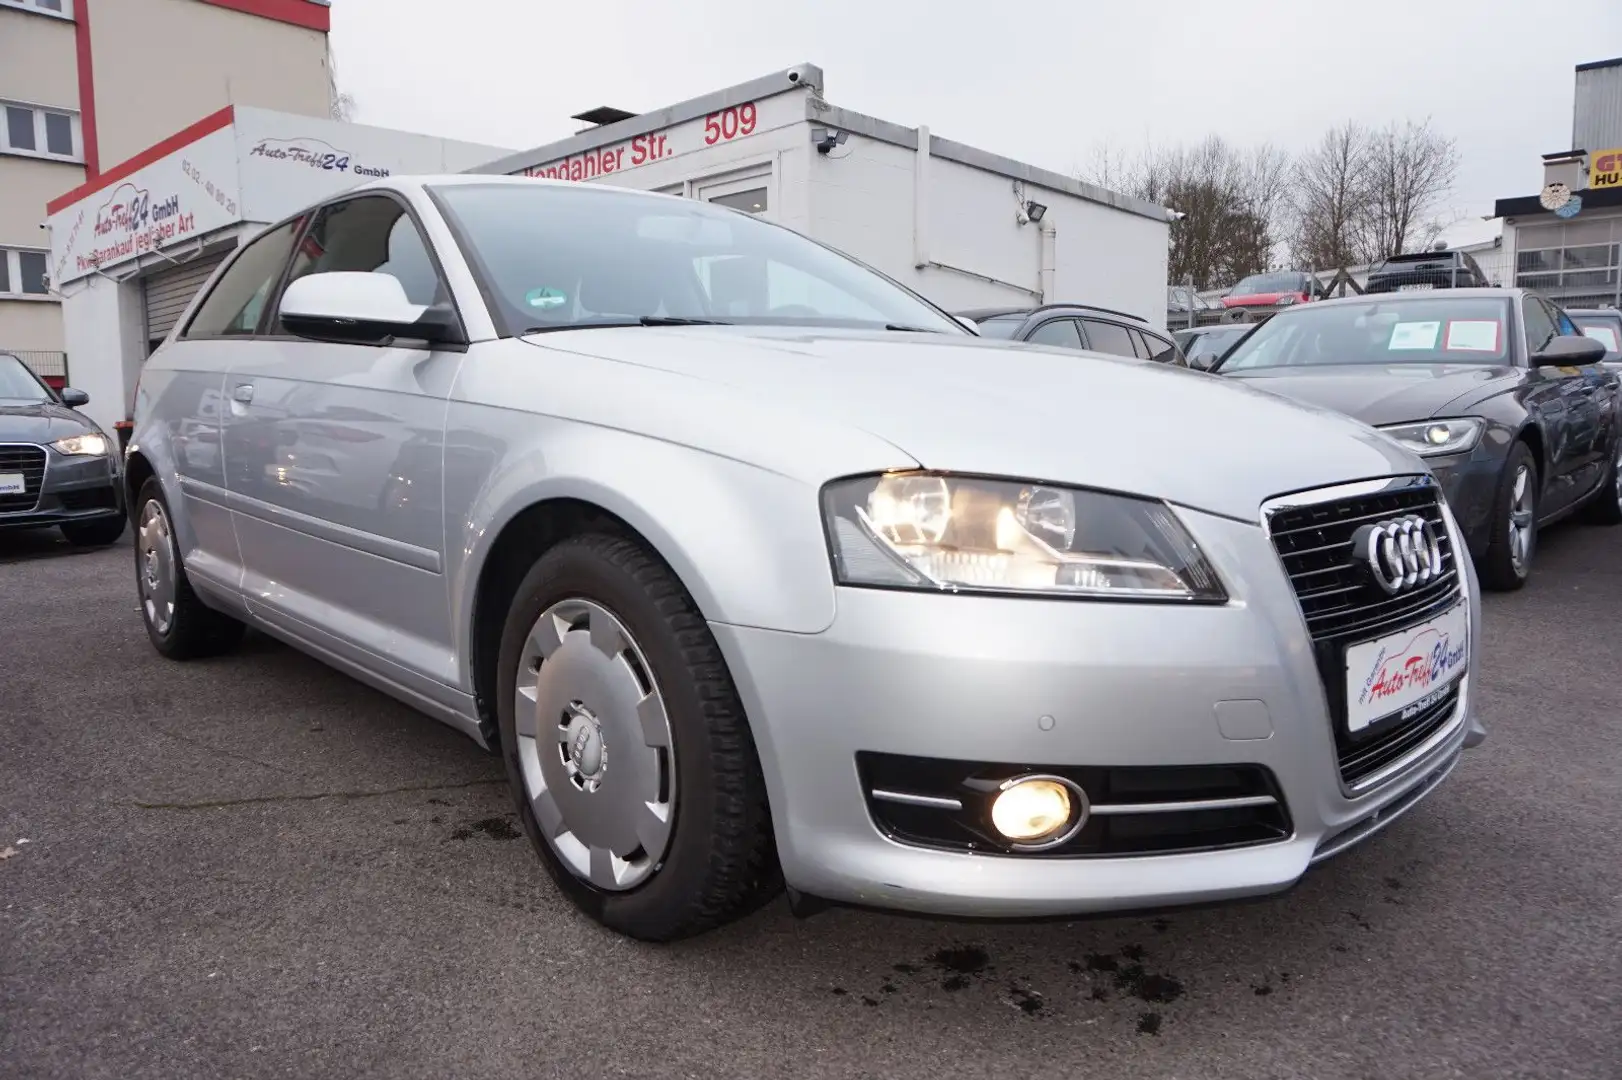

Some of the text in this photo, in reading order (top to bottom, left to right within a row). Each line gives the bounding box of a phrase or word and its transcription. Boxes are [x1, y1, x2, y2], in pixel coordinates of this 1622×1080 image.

[631, 132, 673, 167] Str.
[704, 102, 757, 145] 509
[353, 165, 390, 178] GmbH
[152, 194, 179, 223] GmbH
[178, 211, 195, 234] Art
